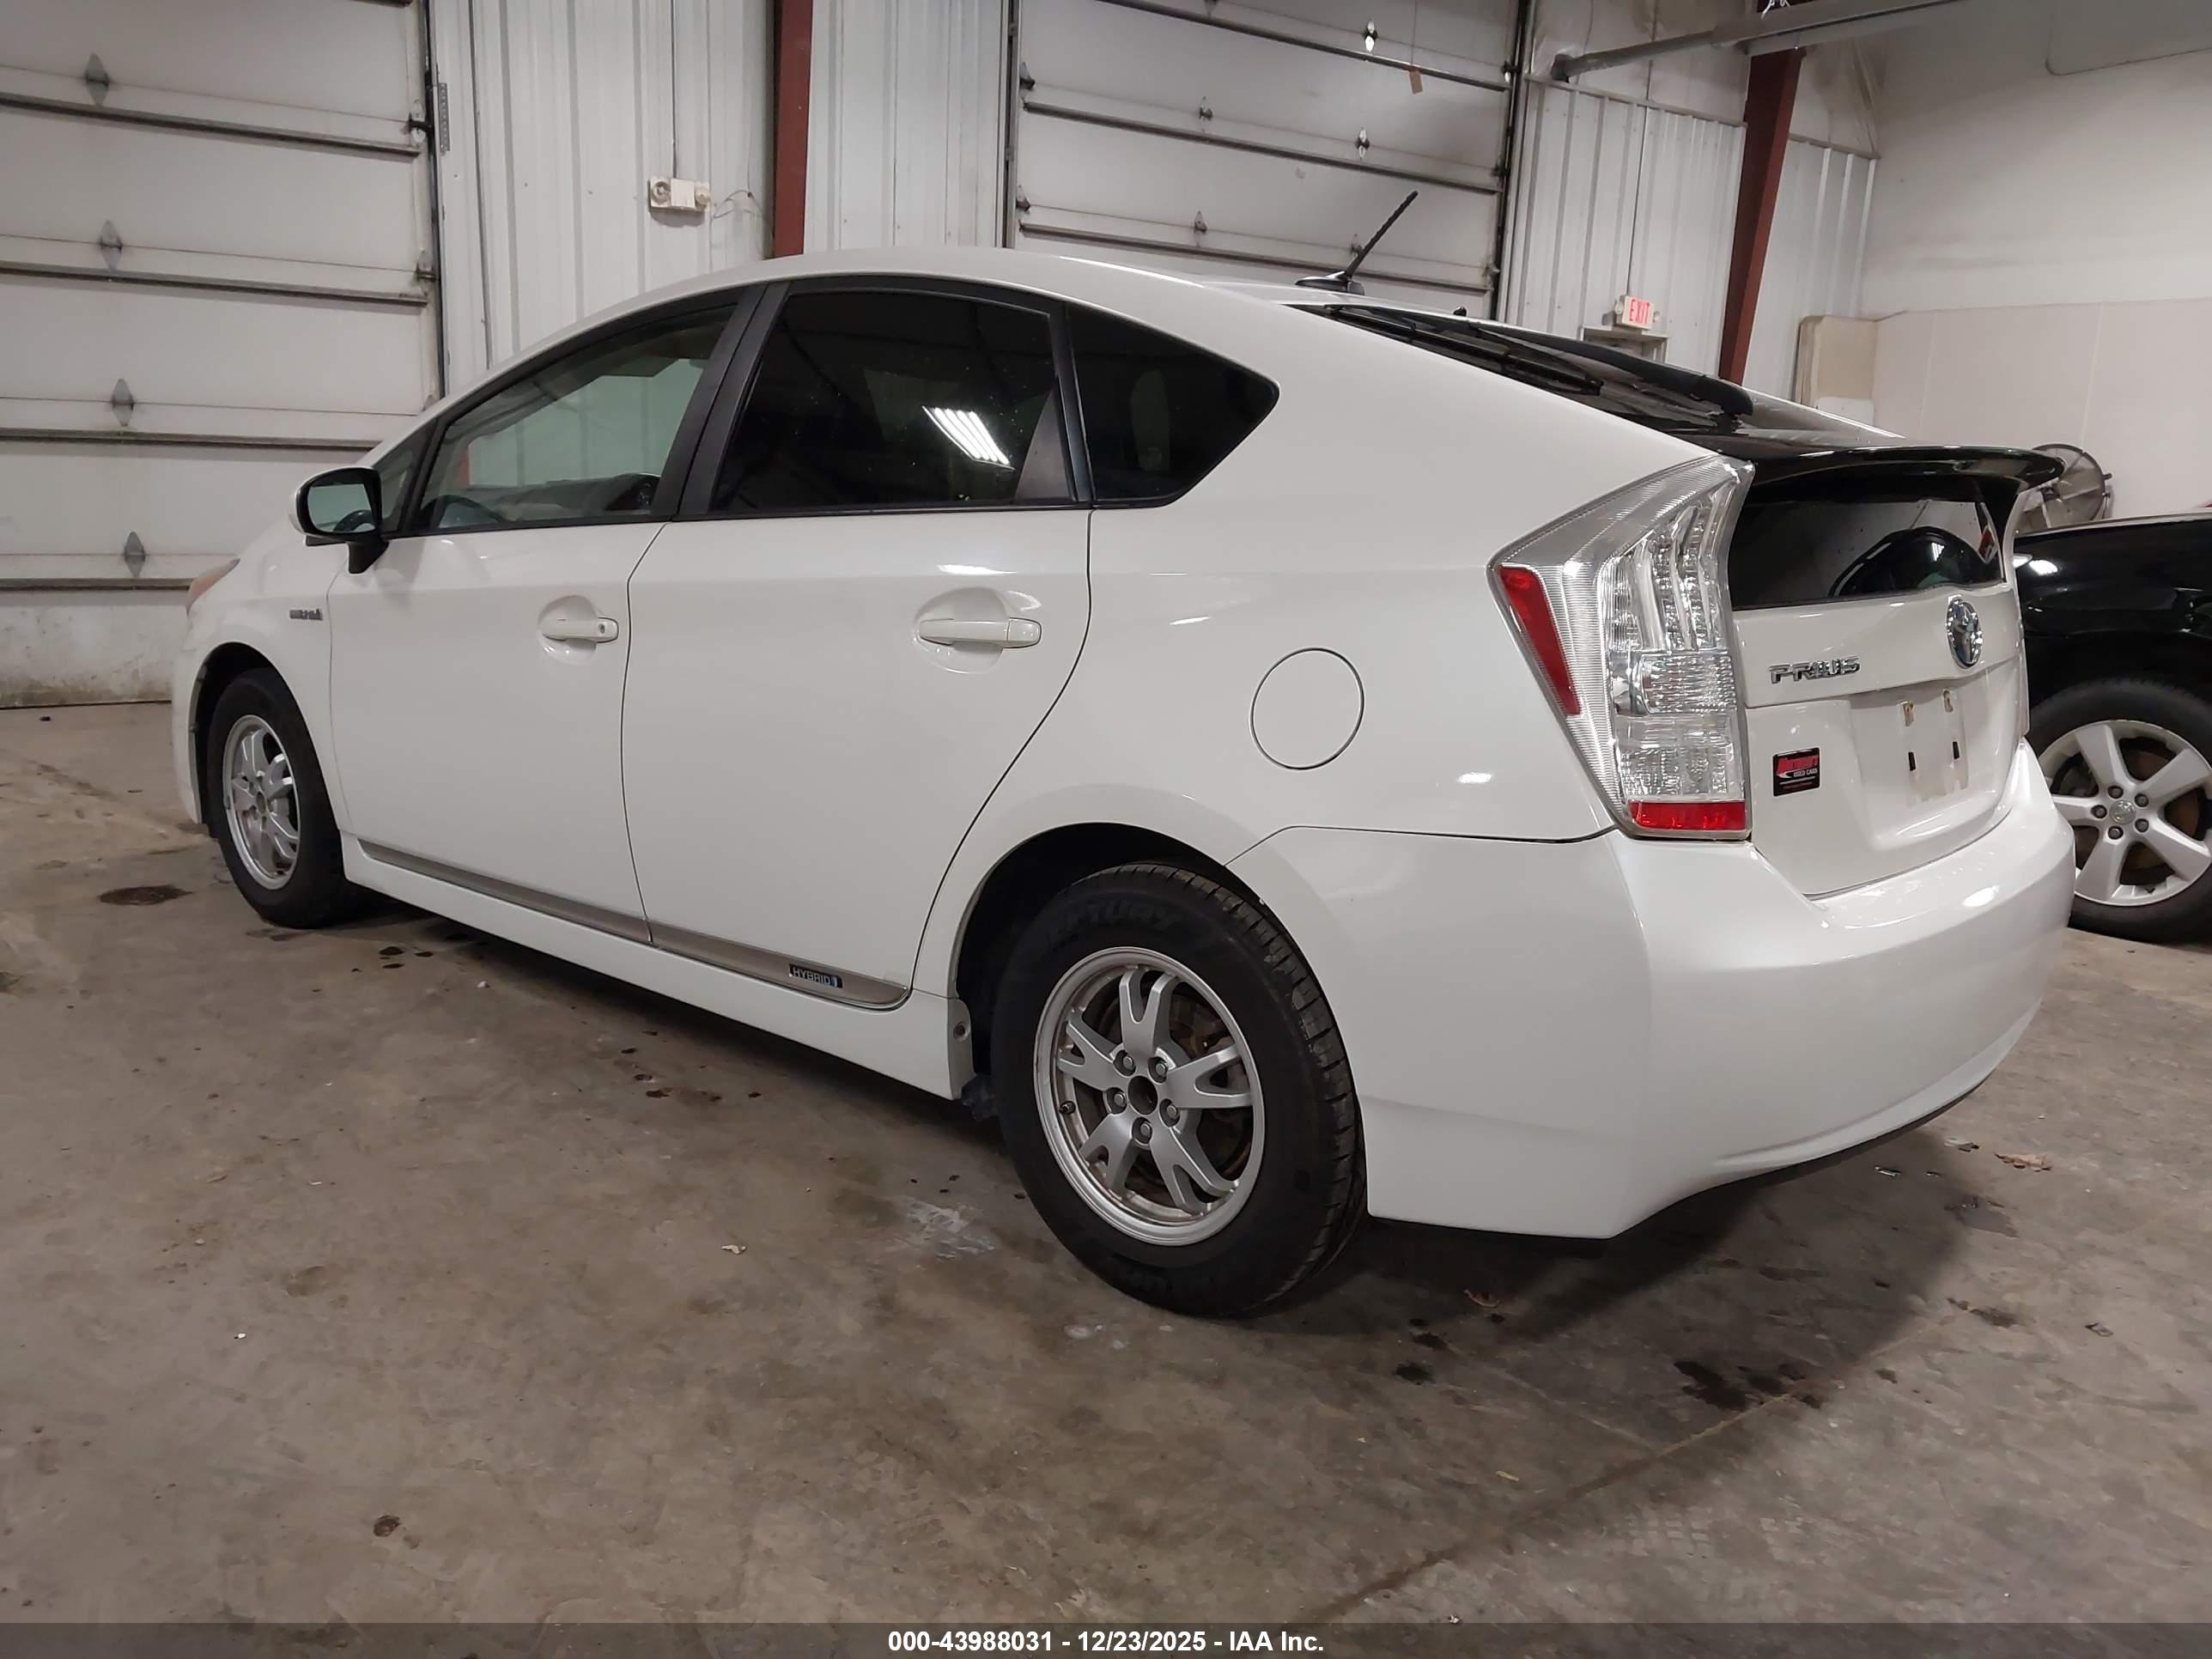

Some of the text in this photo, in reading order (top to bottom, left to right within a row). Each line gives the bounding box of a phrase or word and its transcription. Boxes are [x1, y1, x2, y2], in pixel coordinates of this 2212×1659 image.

[1629, 299, 1650, 323] EXIT
[1769, 655, 1860, 684] PRIUS
[793, 967, 830, 985] HYBRID
